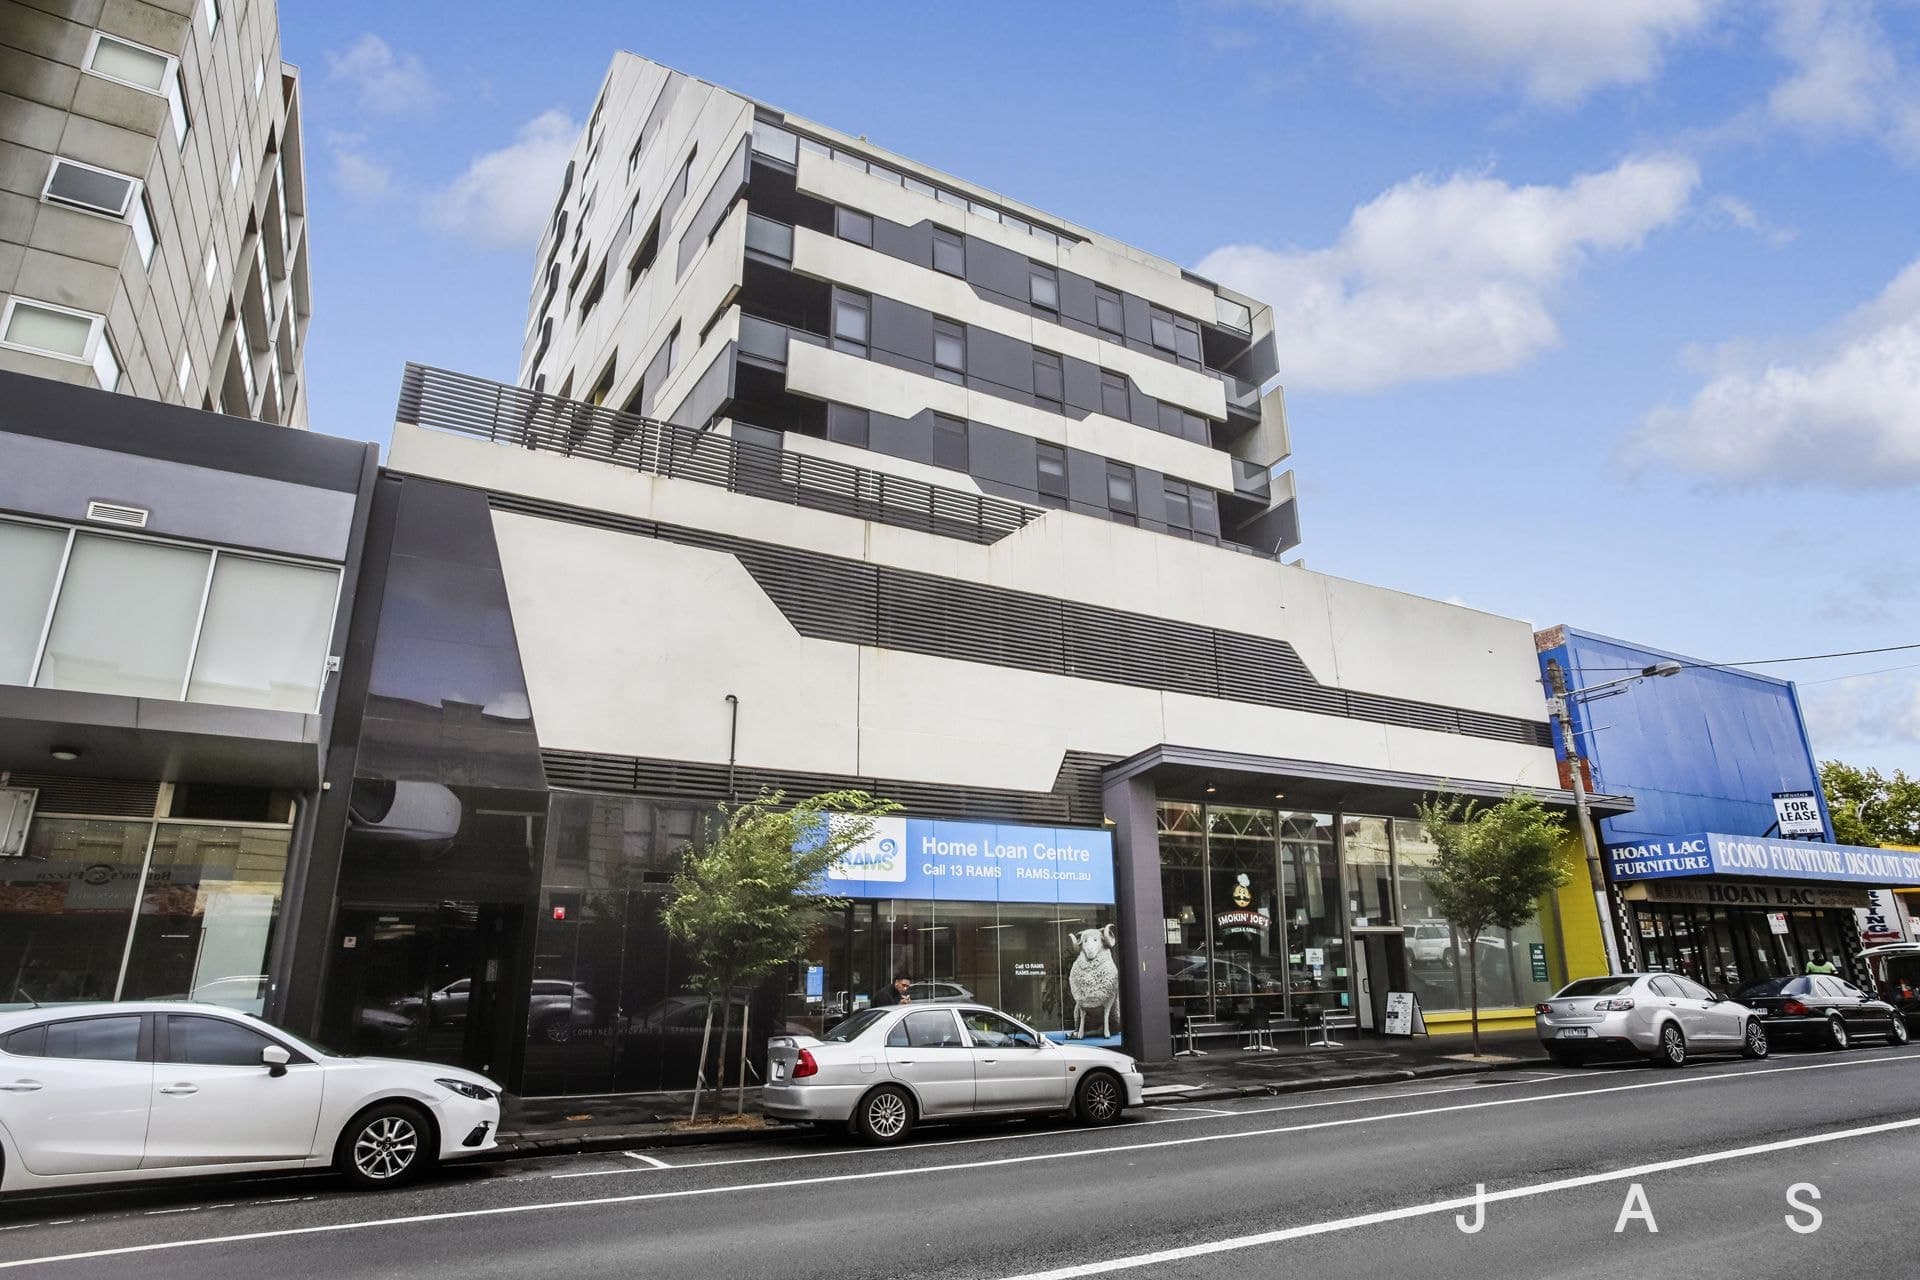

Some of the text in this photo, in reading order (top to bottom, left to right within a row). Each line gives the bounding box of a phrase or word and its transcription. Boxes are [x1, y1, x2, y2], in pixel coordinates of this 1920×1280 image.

[1784, 802, 1808, 811] FOR
[1780, 811, 1817, 821] LEASE
[922, 837, 1090, 862] Home Loan Centre
[1612, 844, 1662, 860] HOAN
[1614, 856, 1710, 875] FURNITURE
[1718, 842, 1768, 868] ECONO
[1769, 846, 1844, 874] FURNITURE
[1845, 852, 1902, 877] DISCOUNT
[922, 864, 1091, 881] Call 13 RAMS RAMS.com.au
[1708, 884, 1769, 904] HOAN
[1218, 913, 1249, 926] SMOKIN'
